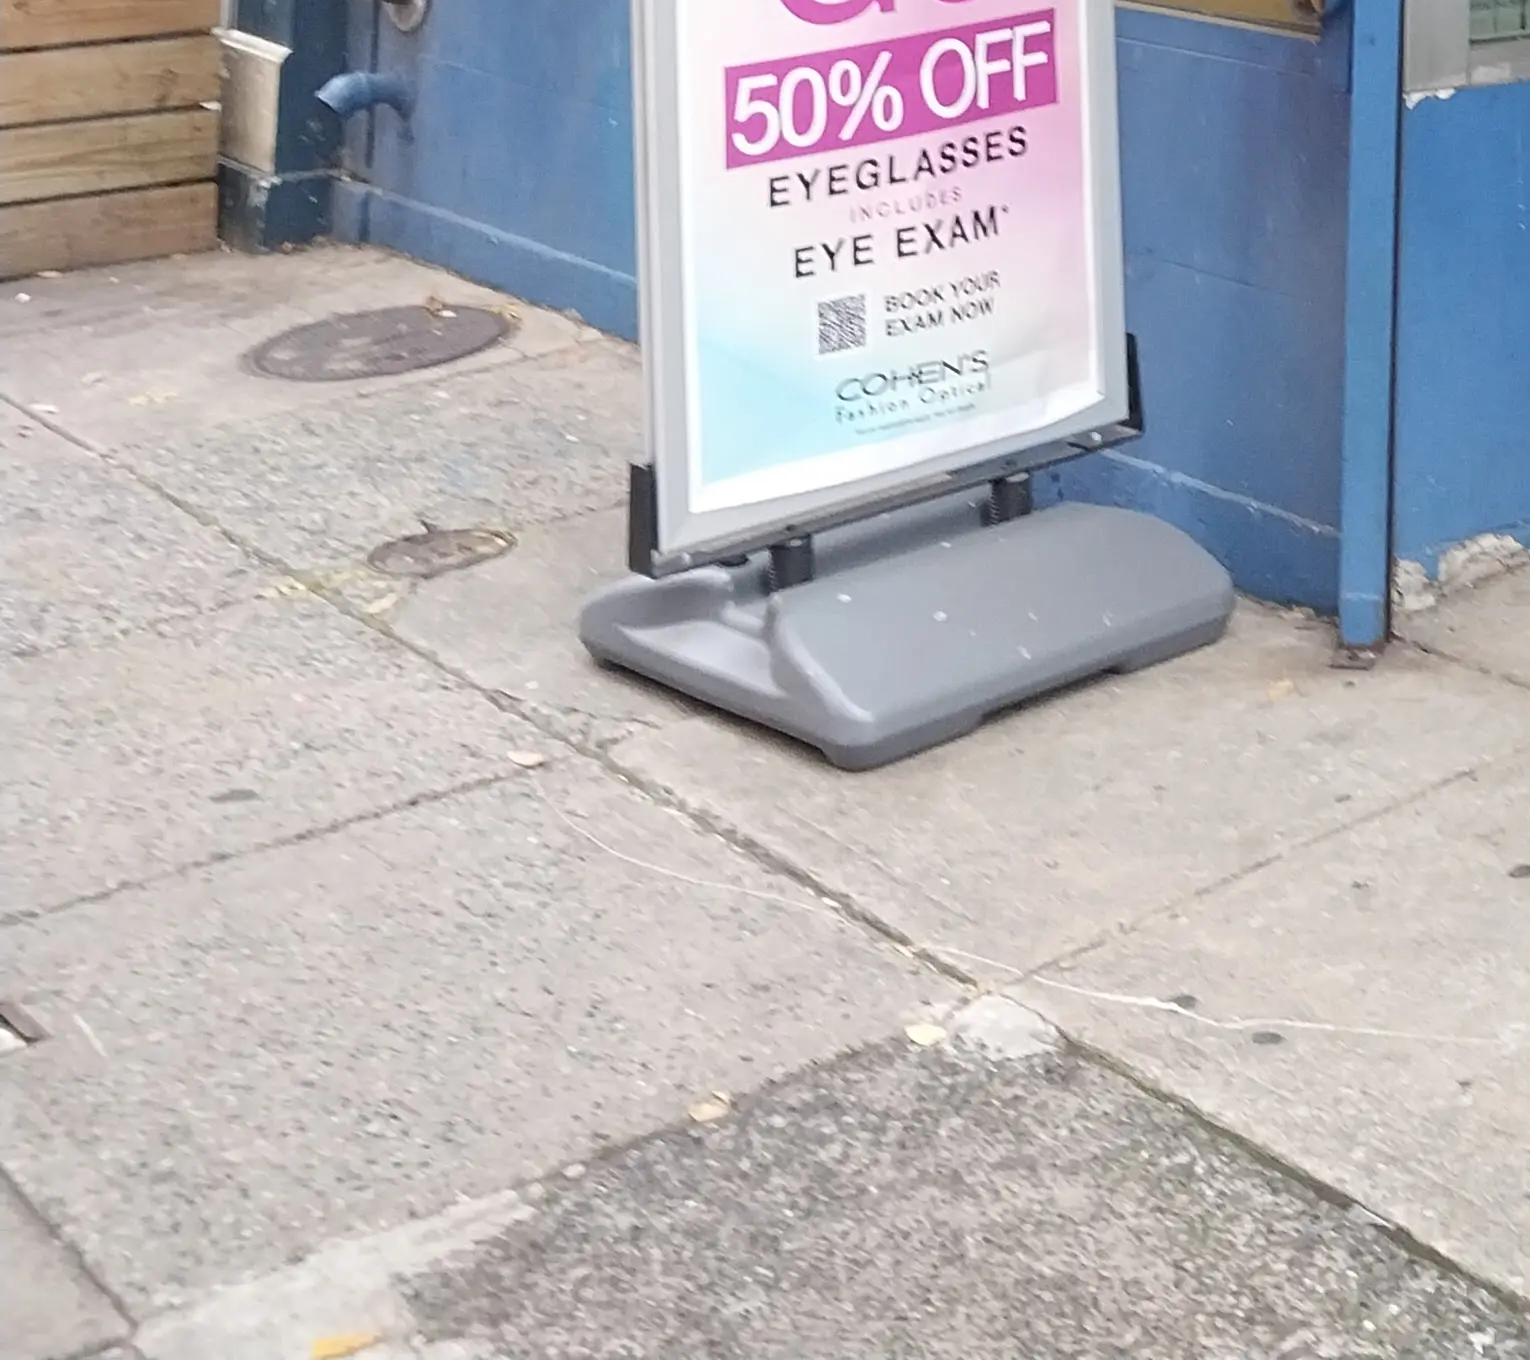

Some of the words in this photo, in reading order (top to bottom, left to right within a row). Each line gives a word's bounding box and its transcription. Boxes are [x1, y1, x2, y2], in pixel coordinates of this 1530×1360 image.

[731, 51, 904, 157] 50%
[919, 20, 1052, 120] OFF
[769, 125, 1029, 208] EYEGLASSES
[849, 186, 962, 223] INCLUDES
[795, 233, 875, 279] EYE
[884, 285, 944, 313] BOOK
[948, 270, 1001, 299] YOUR
[885, 310, 943, 337] EXAM
[950, 297, 995, 323] NOW
[835, 399, 909, 424] Fashion
